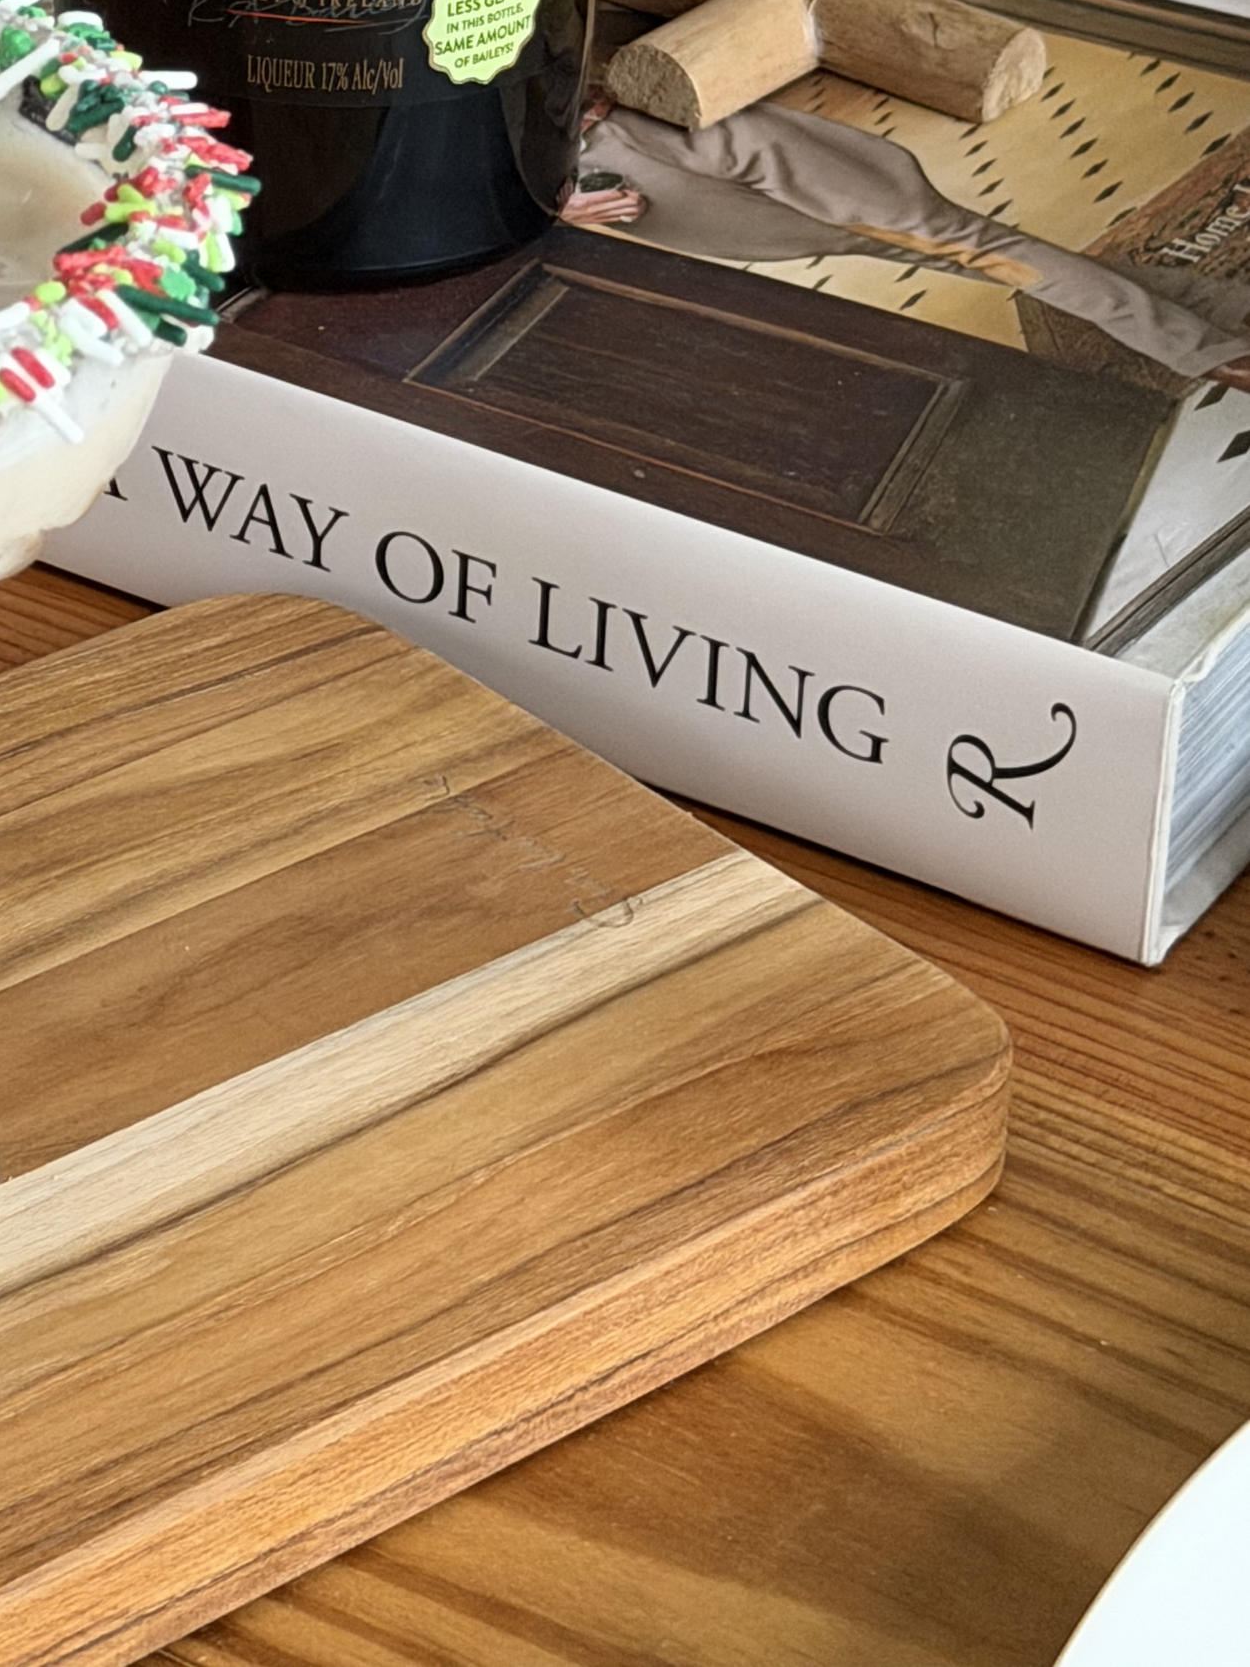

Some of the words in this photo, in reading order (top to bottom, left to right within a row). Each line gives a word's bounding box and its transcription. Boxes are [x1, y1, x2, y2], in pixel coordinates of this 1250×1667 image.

[435, 34, 474, 56] SAME
[476, 14, 531, 47] AMOUNT
[447, 22, 459, 34] IN
[462, 15, 485, 31] THIS
[247, 54, 316, 93] LIQUEUR
[321, 62, 349, 92] 17%
[351, 57, 405, 96] Alc/Vol
[454, 55, 470, 69] OF
[151, 445, 350, 573] WAY
[375, 530, 497, 624] OF
[528, 575, 890, 765] LIVING
